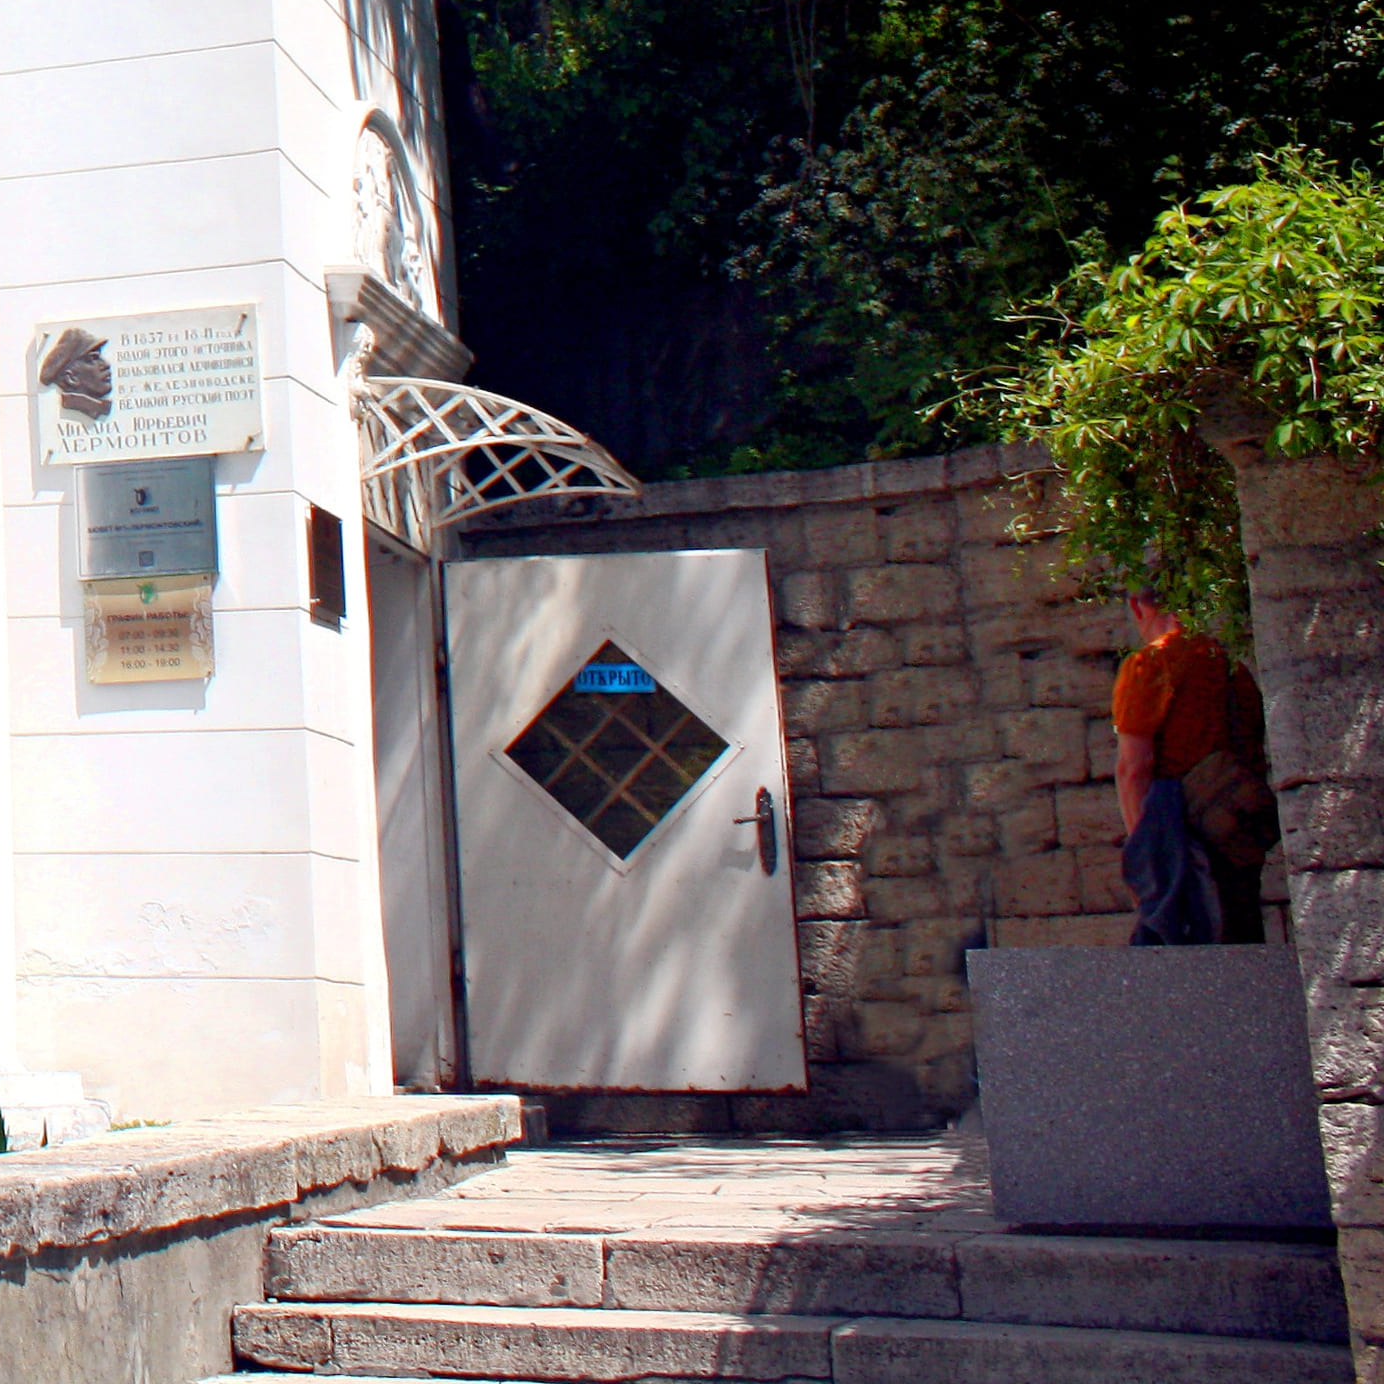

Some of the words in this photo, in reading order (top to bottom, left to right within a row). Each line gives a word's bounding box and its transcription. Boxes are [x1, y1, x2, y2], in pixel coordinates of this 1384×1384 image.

[134, 331, 164, 344] 1837
[116, 349, 151, 362] ВОДОЙ
[154, 345, 188, 359] ЭТОГО
[193, 340, 253, 355] ИСТОЧНИКА
[117, 361, 185, 378] ПОЛЬЗОВАЛСЯ
[143, 374, 256, 392] ЖЕЛЕЗНОВОДСКЕ
[119, 396, 169, 410] ВЕЛИКИЙ
[173, 391, 222, 405] РУССКИЙ
[225, 389, 254, 402] ПОЭТ
[57, 421, 121, 437] МИХАИЛ
[133, 414, 207, 432] ЮРЬЕВИЧ
[61, 429, 207, 454] ЛЕРМОНТОВ
[577, 669, 652, 687] ОТКРЫТО
